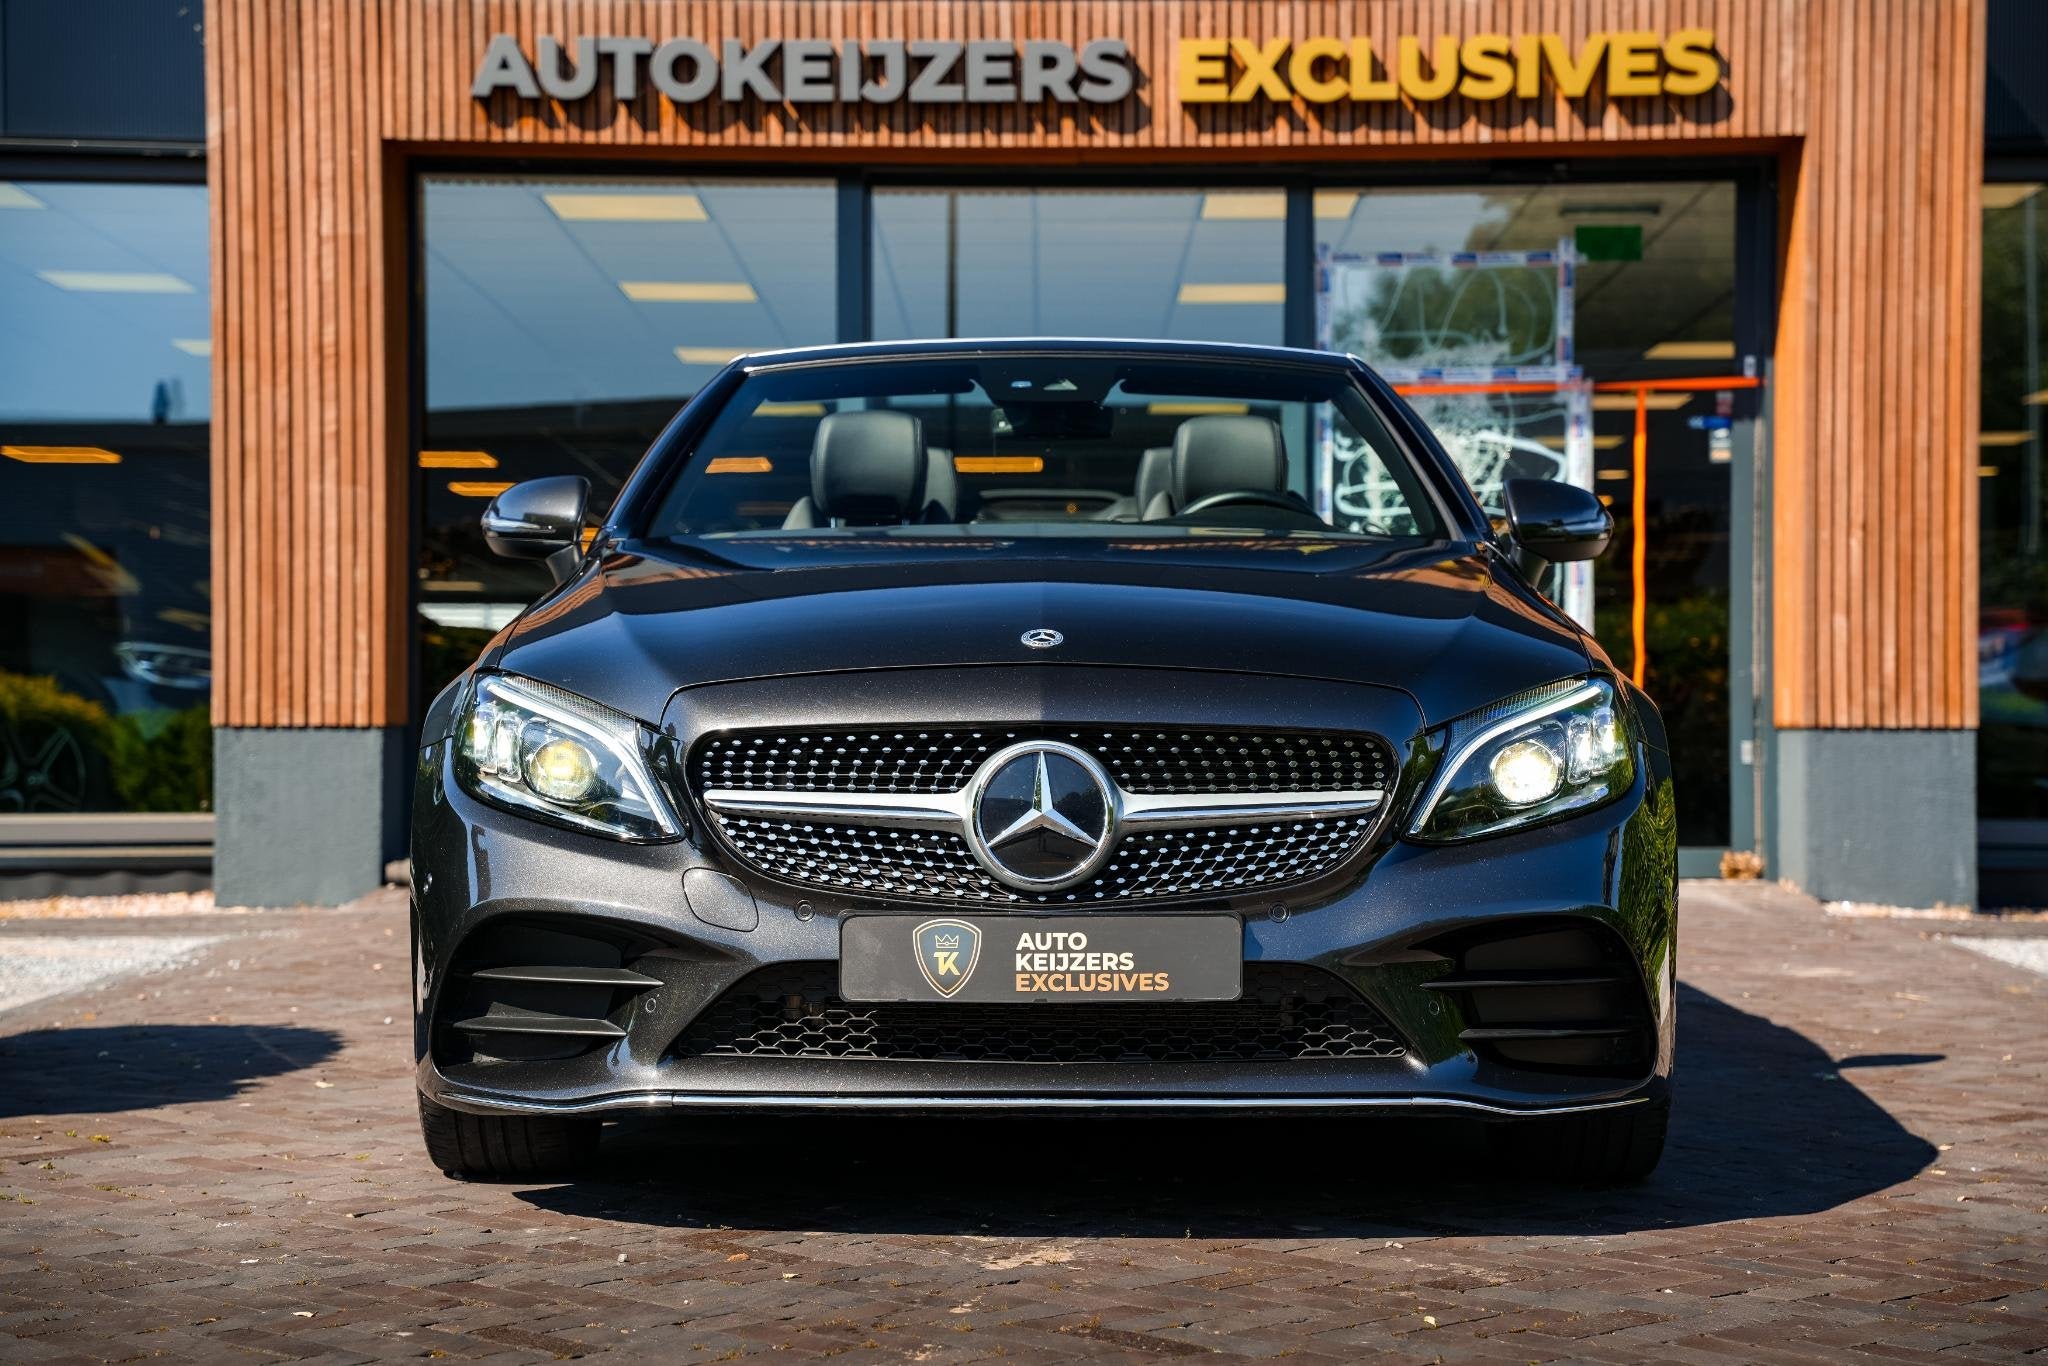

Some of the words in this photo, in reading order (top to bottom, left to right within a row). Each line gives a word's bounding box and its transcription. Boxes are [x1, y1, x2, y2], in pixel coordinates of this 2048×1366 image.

[471, 33, 1133, 103] AUTOKEIJZERS
[1179, 29, 1720, 102] EXCLUSIVES
[1016, 932, 1087, 951] AUTO
[1015, 952, 1135, 971] KEIJZERS
[1015, 972, 1170, 992] EXCLUSIVES
